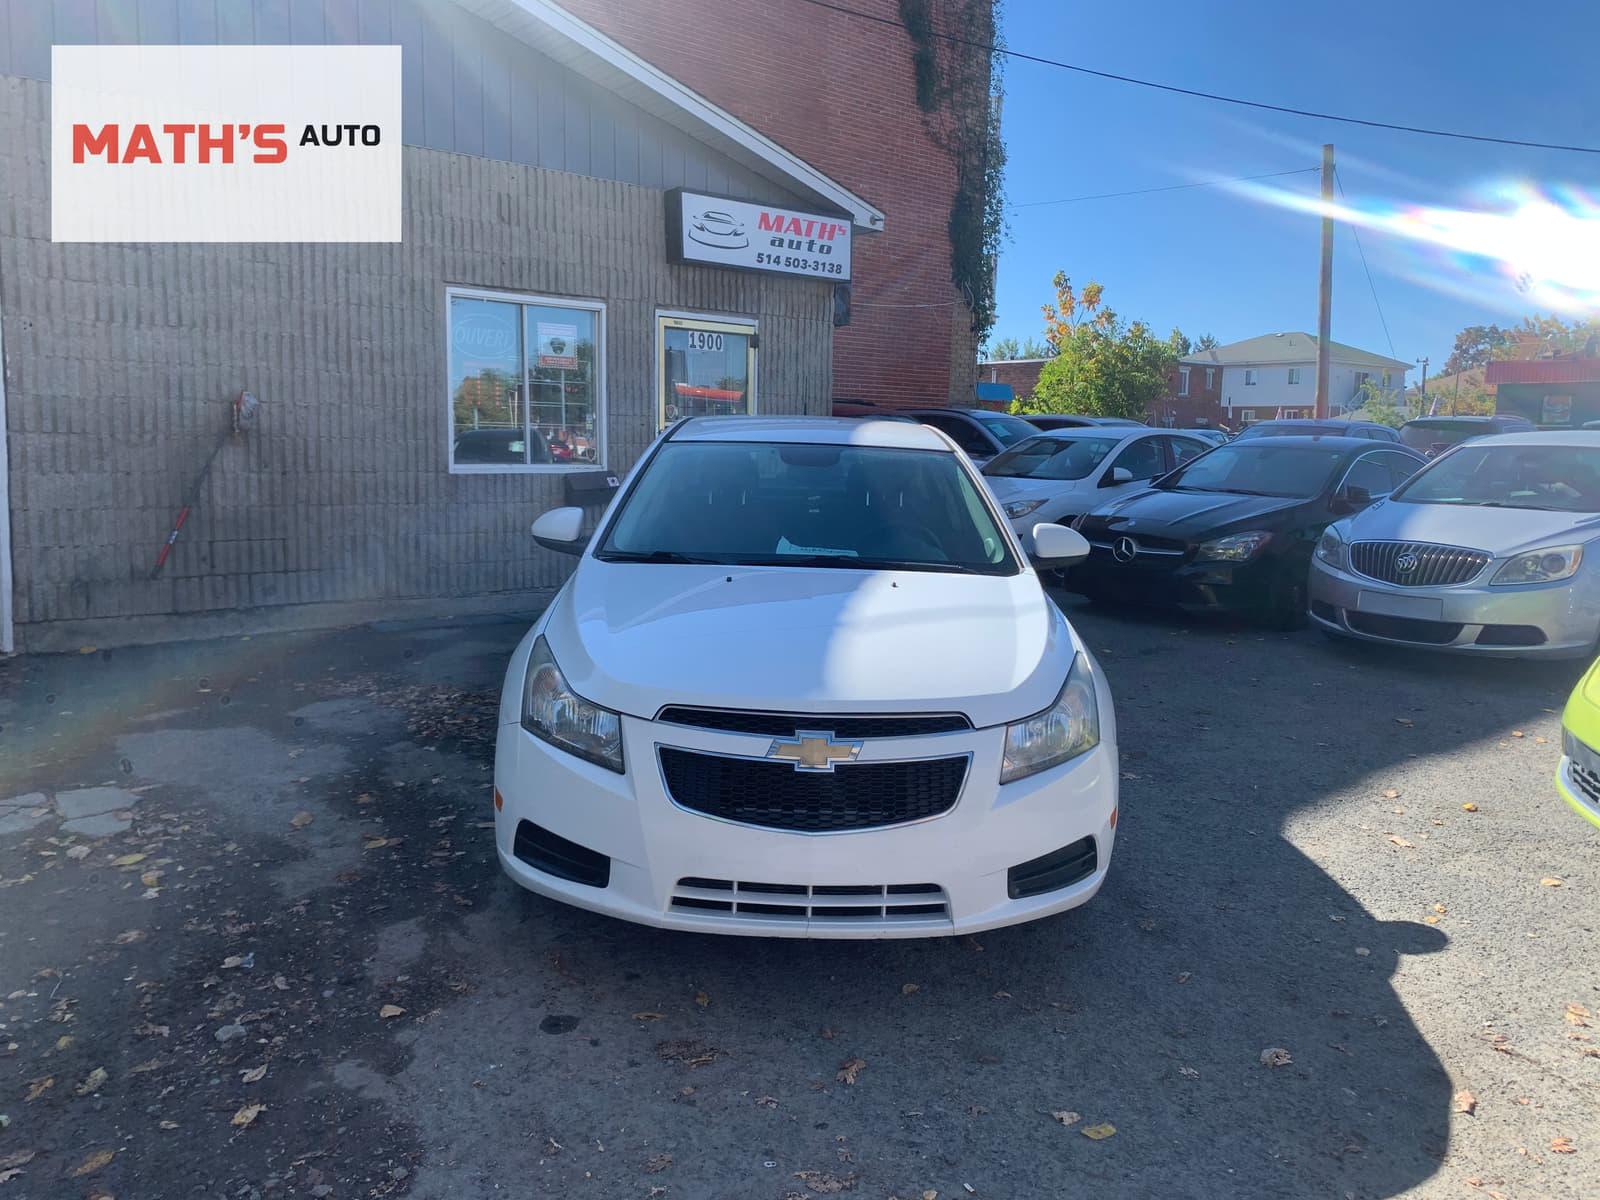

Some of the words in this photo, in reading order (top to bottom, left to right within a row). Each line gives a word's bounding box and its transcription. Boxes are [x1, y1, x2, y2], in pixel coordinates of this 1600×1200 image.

[769, 236, 833, 255] auto
[756, 252, 781, 266] 514
[784, 258, 843, 275] 503-3138
[689, 331, 723, 351] 1900
